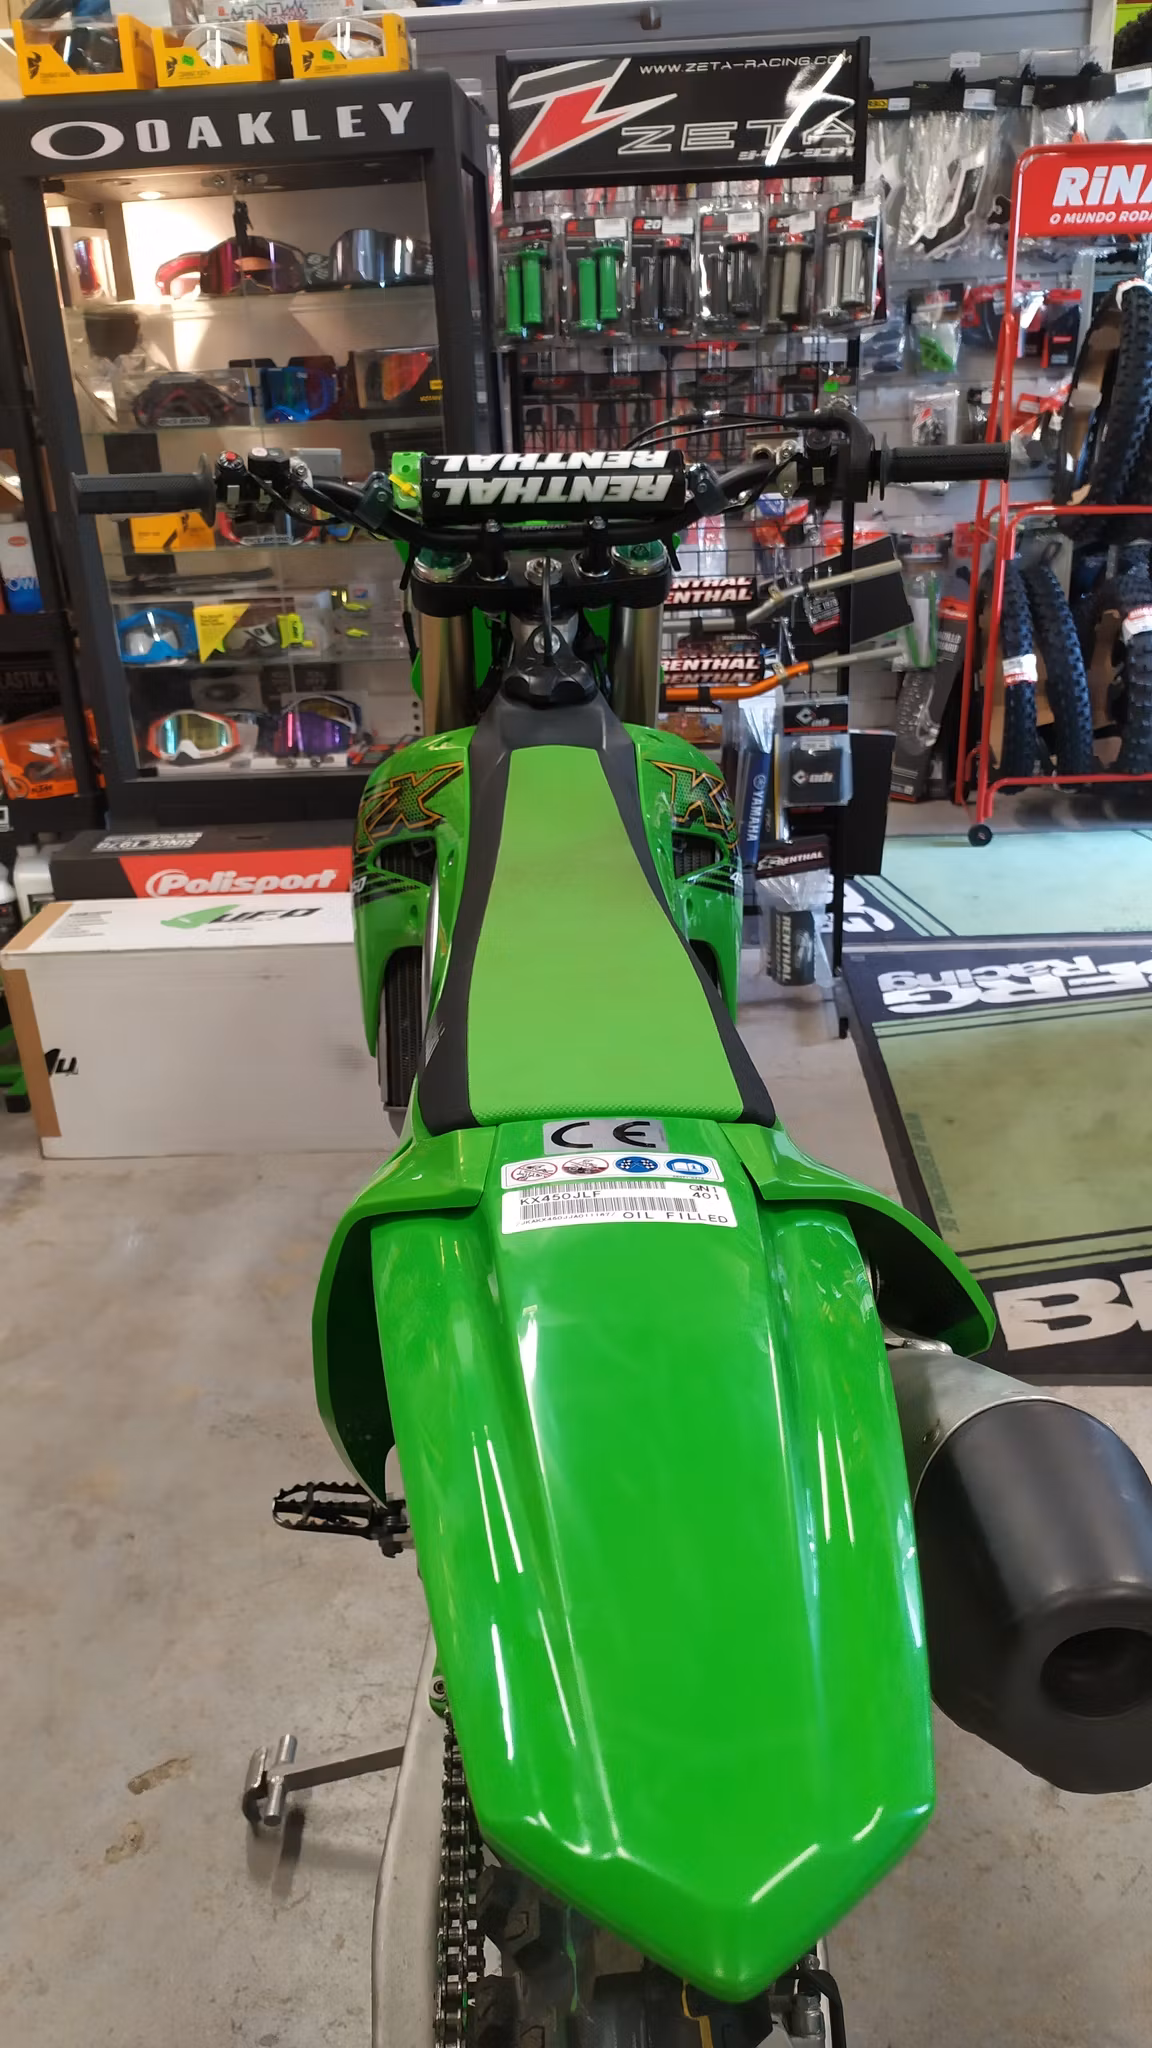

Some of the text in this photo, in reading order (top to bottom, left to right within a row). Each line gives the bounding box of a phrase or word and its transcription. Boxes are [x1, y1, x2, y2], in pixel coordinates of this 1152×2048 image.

[638, 55, 852, 75] WWW.ZETA-RACING.COM
[135, 101, 414, 153] OAKLEY
[617, 115, 856, 154] ZETA
[1050, 213, 1061, 225] O
[1063, 211, 1117, 225] MUNDO
[435, 450, 670, 472] RENTHAL
[435, 474, 674, 506] RENTHAL
[664, 588, 753, 604] ENTHAL
[746, 790, 764, 842] YAMAHA
[156, 869, 337, 896] Polisport
[782, 915, 792, 982] RENTHAL
[878, 955, 1098, 992] Racing
[883, 959, 1152, 1014] ERG
[520, 1190, 602, 1206] KX450JLF
[622, 1211, 654, 1220] OIL
[666, 1211, 728, 1224] FILLED
